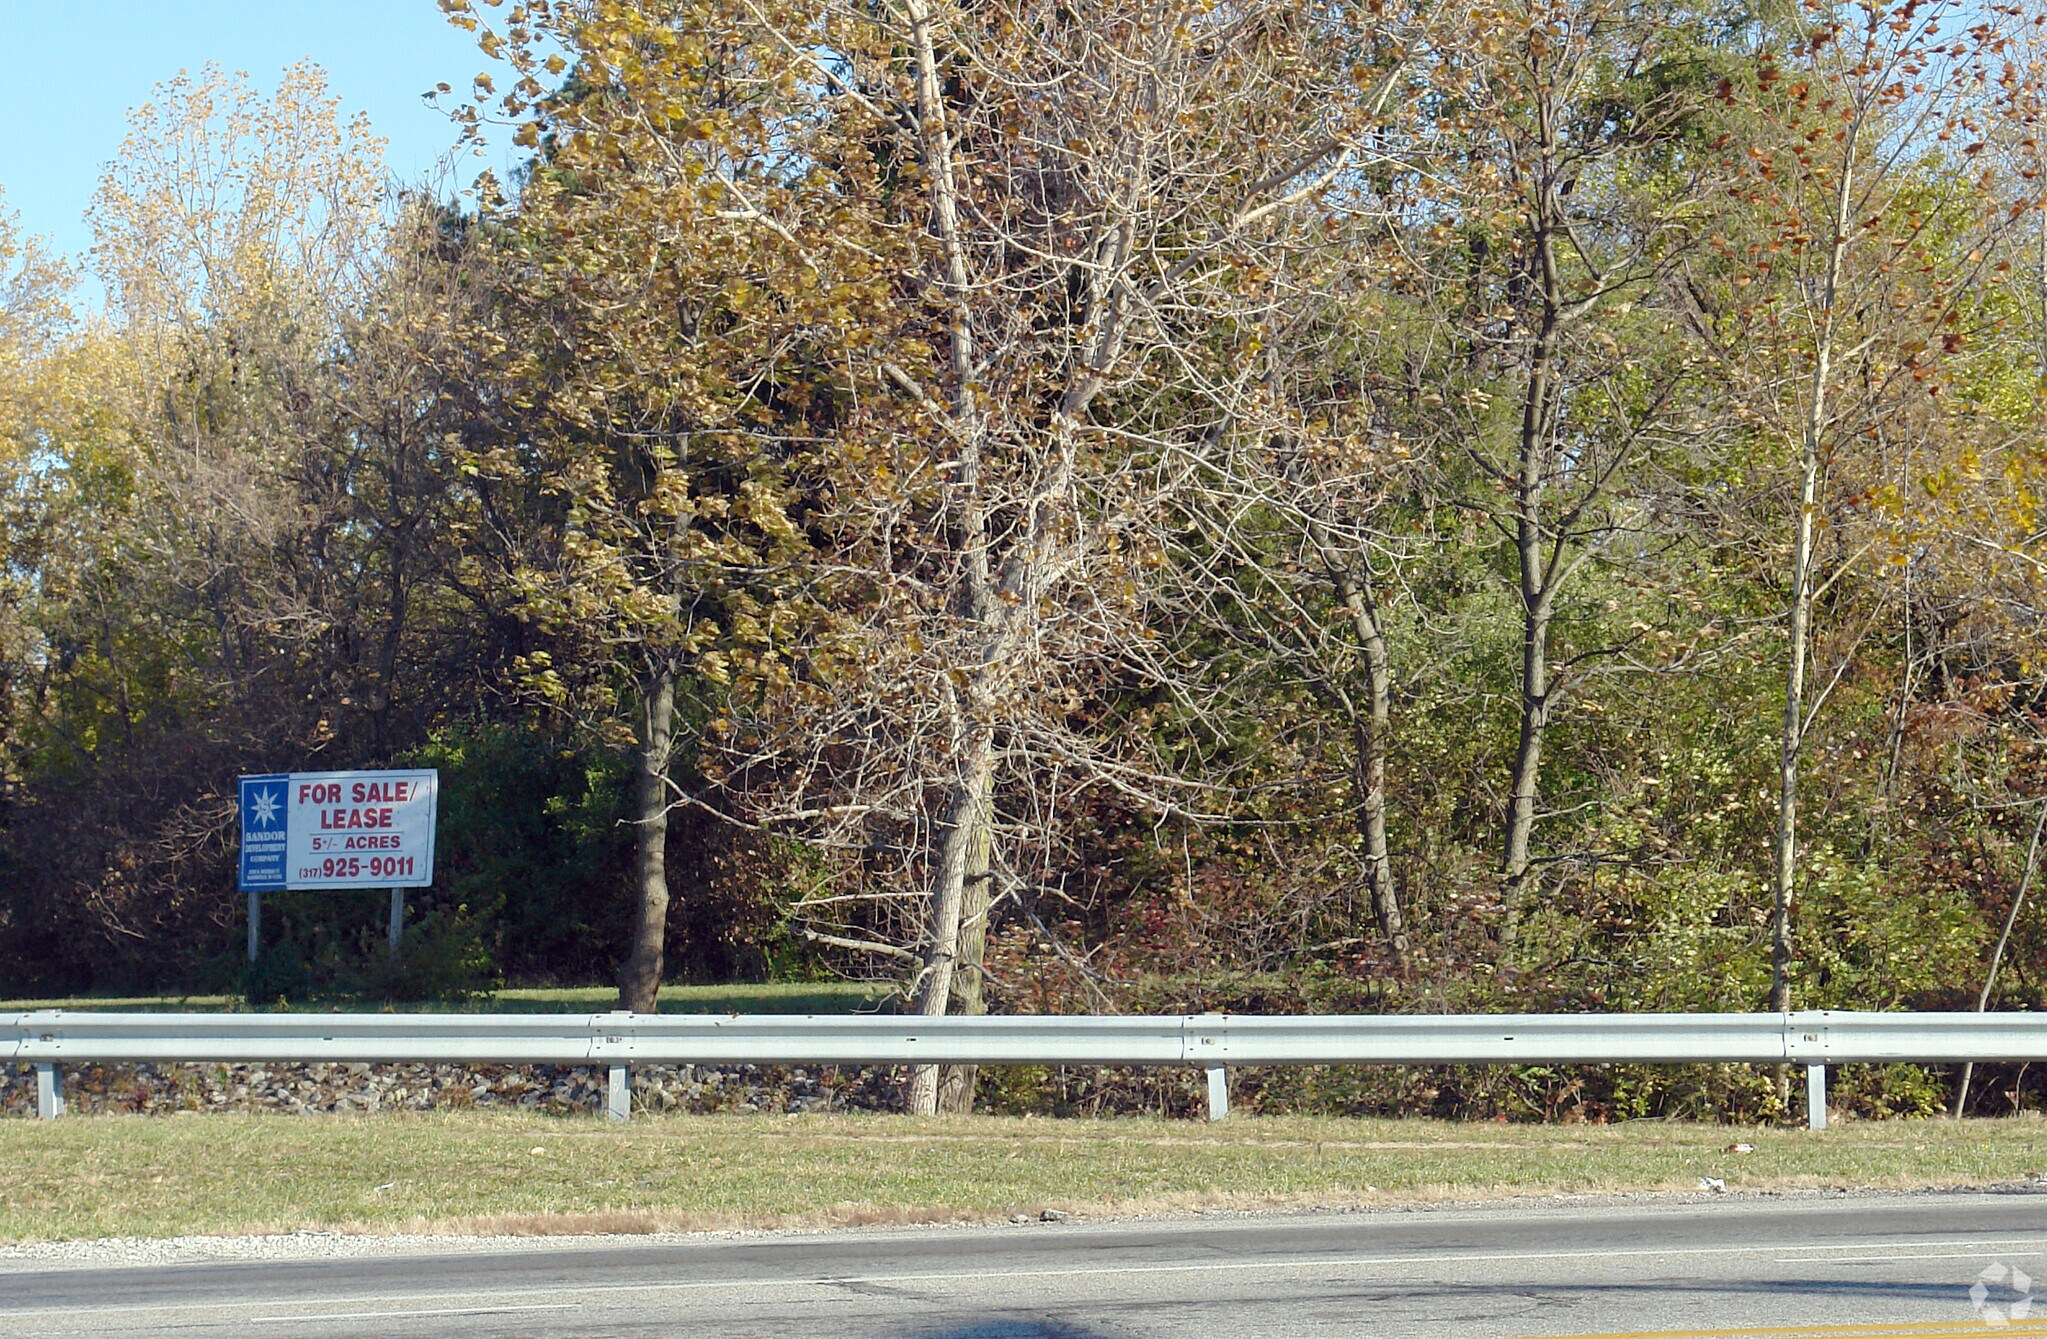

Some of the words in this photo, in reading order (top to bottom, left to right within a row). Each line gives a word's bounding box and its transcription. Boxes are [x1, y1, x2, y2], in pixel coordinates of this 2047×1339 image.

[298, 783, 342, 804] FOR
[352, 781, 418, 803] SALE/
[320, 807, 393, 829] LEASE
[245, 830, 286, 842] SANDOR
[344, 835, 401, 849] ACRES
[249, 854, 280, 863] COMPANY
